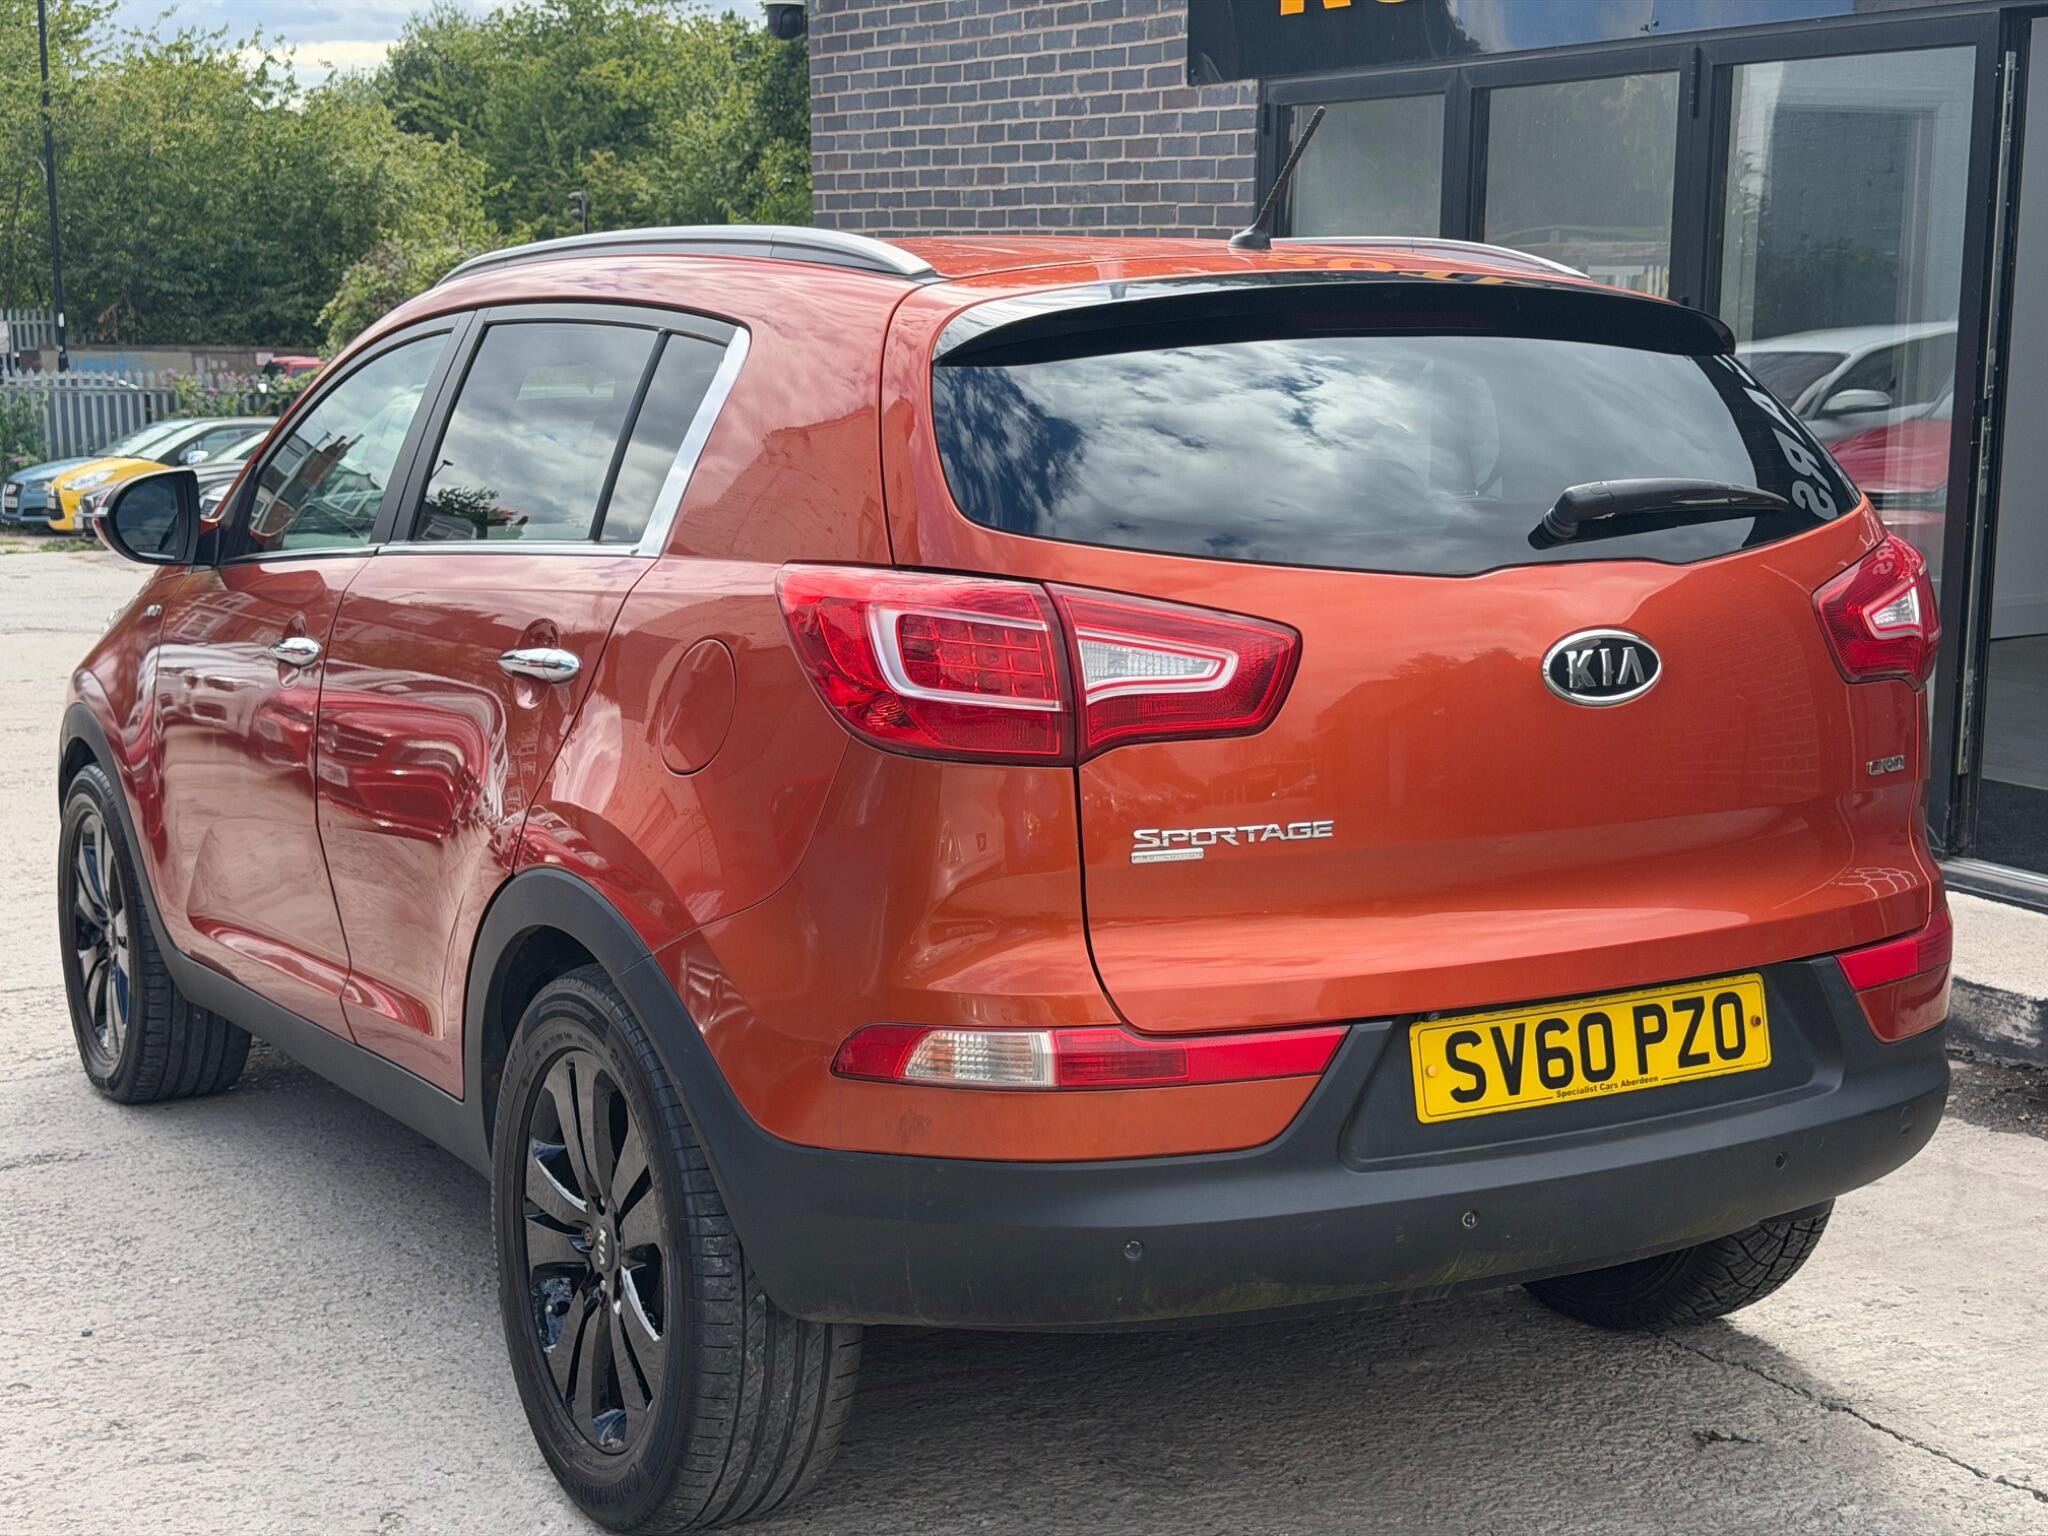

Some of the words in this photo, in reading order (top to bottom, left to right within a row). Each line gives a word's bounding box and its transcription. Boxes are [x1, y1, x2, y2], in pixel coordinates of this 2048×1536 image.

[1565, 646, 1646, 689] KIA
[1132, 820, 1335, 849] SPORTAGE
[1445, 1012, 1616, 1104] SV60
[1632, 991, 1747, 1076] PZO
[1555, 1085, 1598, 1099] Specialist
[1599, 1082, 1619, 1092] Cars
[1620, 1076, 1659, 1088] Aberdeen
